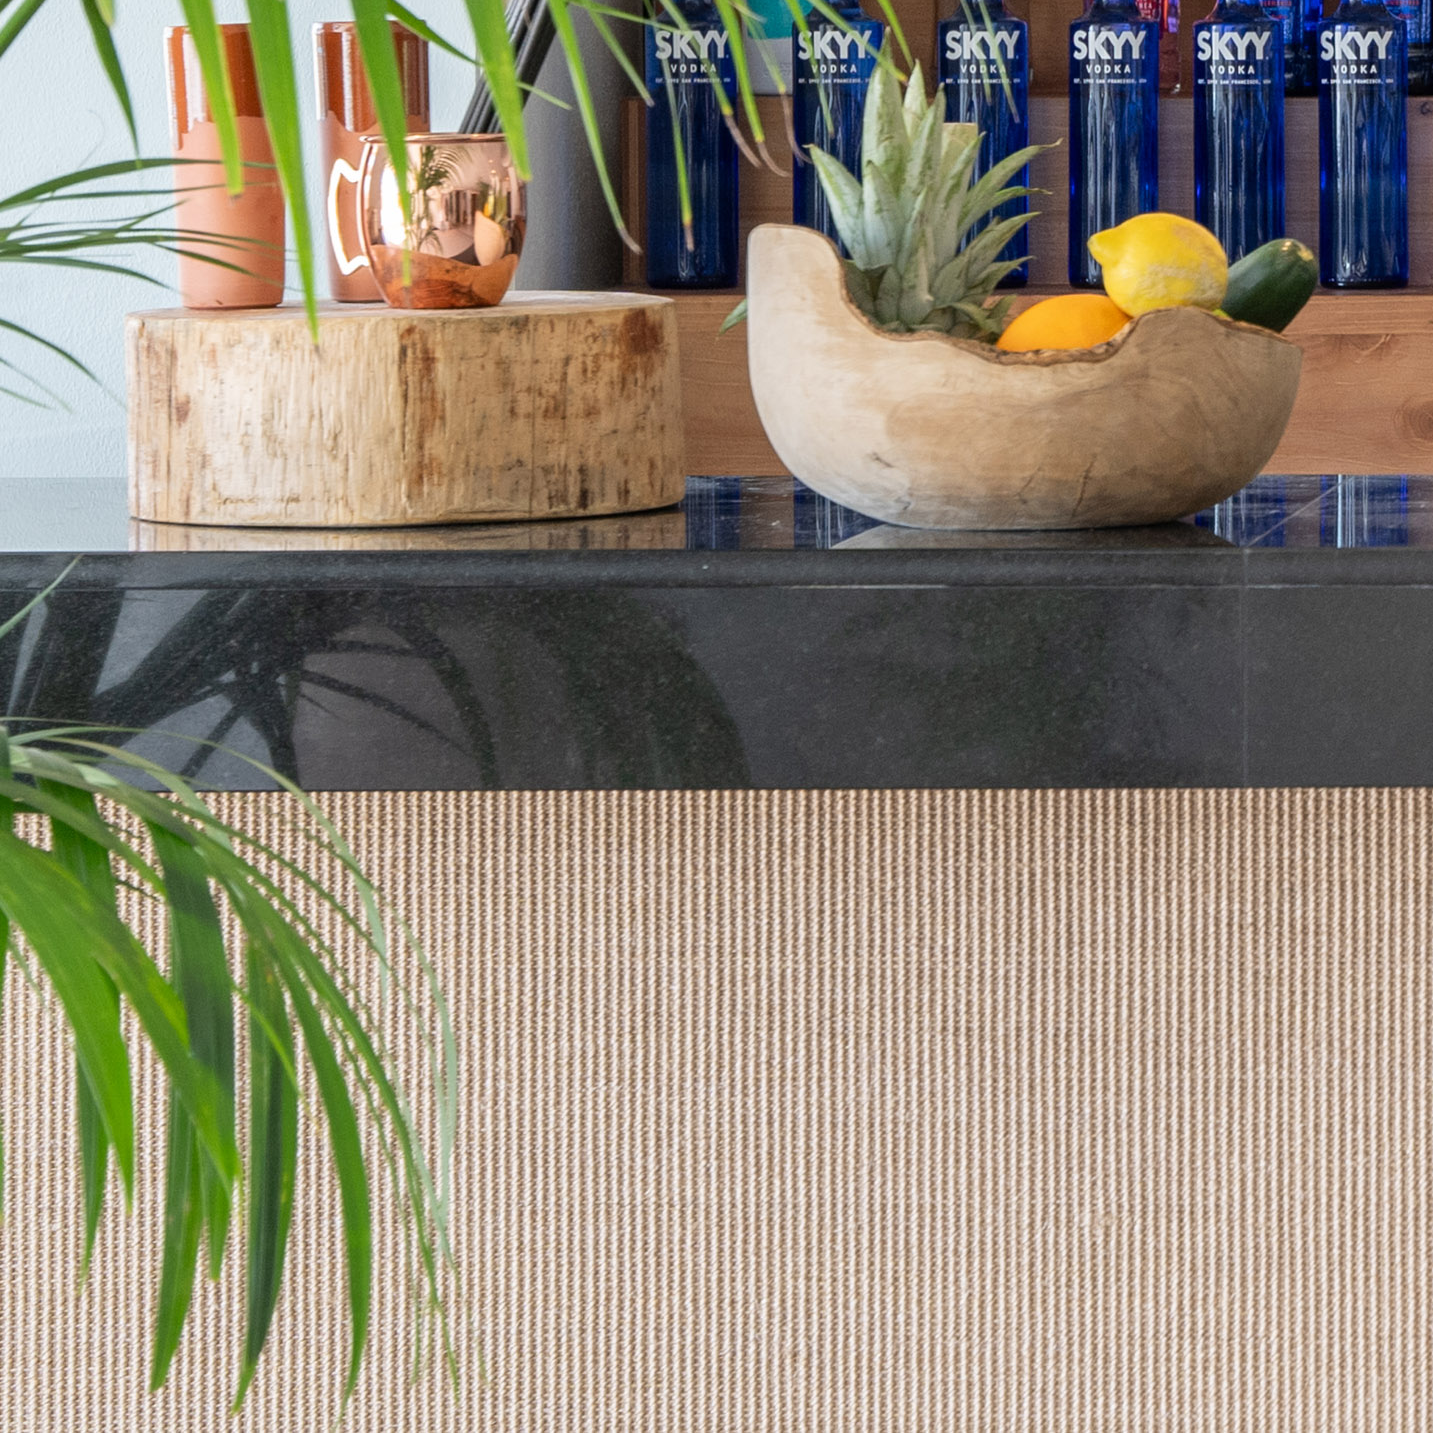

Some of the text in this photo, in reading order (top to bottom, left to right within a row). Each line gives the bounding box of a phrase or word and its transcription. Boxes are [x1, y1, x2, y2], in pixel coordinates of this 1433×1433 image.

[655, 30, 729, 59] SKYY
[797, 30, 872, 59] SKYY
[945, 30, 1020, 59] SKYY
[1073, 30, 1146, 60] SKYY
[1197, 30, 1271, 60] SKYY
[1320, 30, 1393, 61] SKYY
[670, 63, 717, 73] VODKA
[811, 64, 857, 74] VODKA
[960, 64, 1007, 74] VODKA
[1085, 64, 1131, 74] VODKA
[1209, 65, 1255, 75] VODKA
[1332, 64, 1378, 74] VODKA
